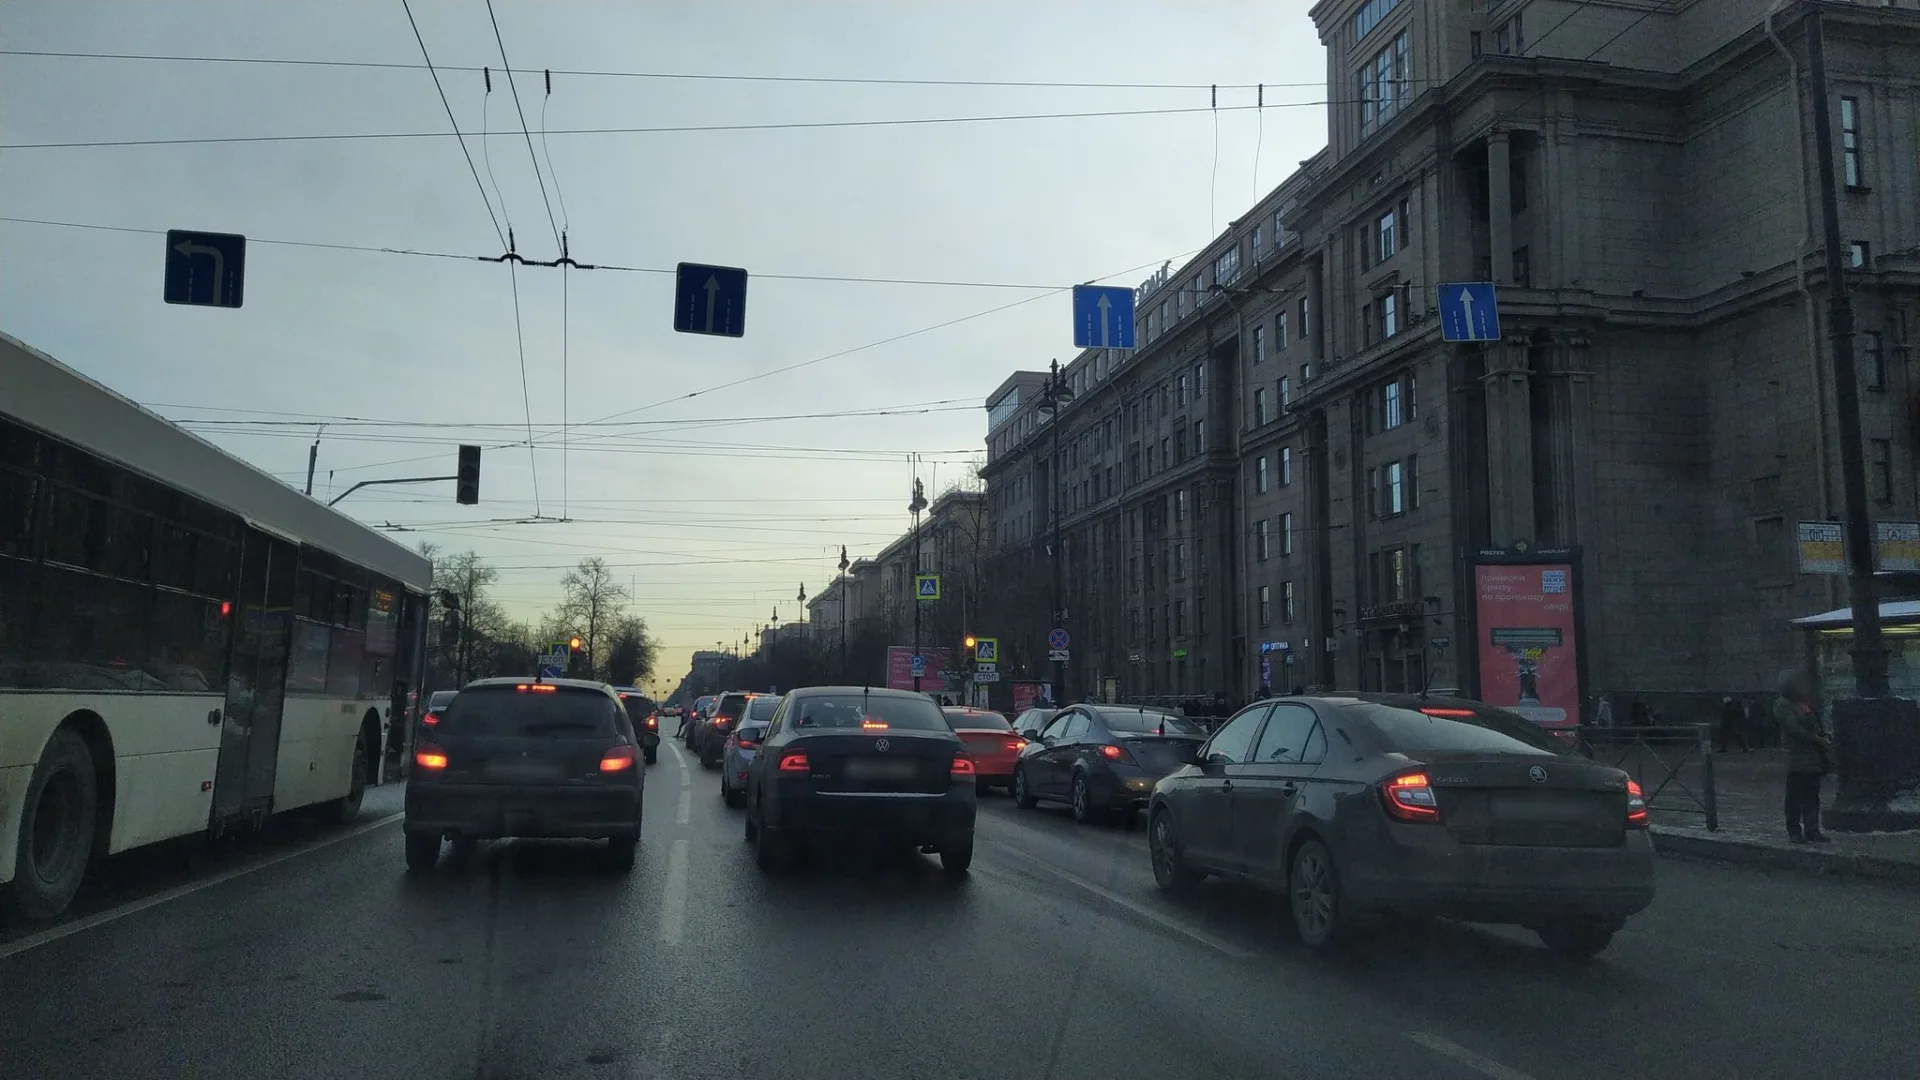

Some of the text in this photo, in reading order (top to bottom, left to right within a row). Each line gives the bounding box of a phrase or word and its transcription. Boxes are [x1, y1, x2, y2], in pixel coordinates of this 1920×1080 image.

[1270, 641, 1289, 651] ОПТИКА
[543, 655, 564, 664] СТОП
[977, 673, 997, 681] СТОП
